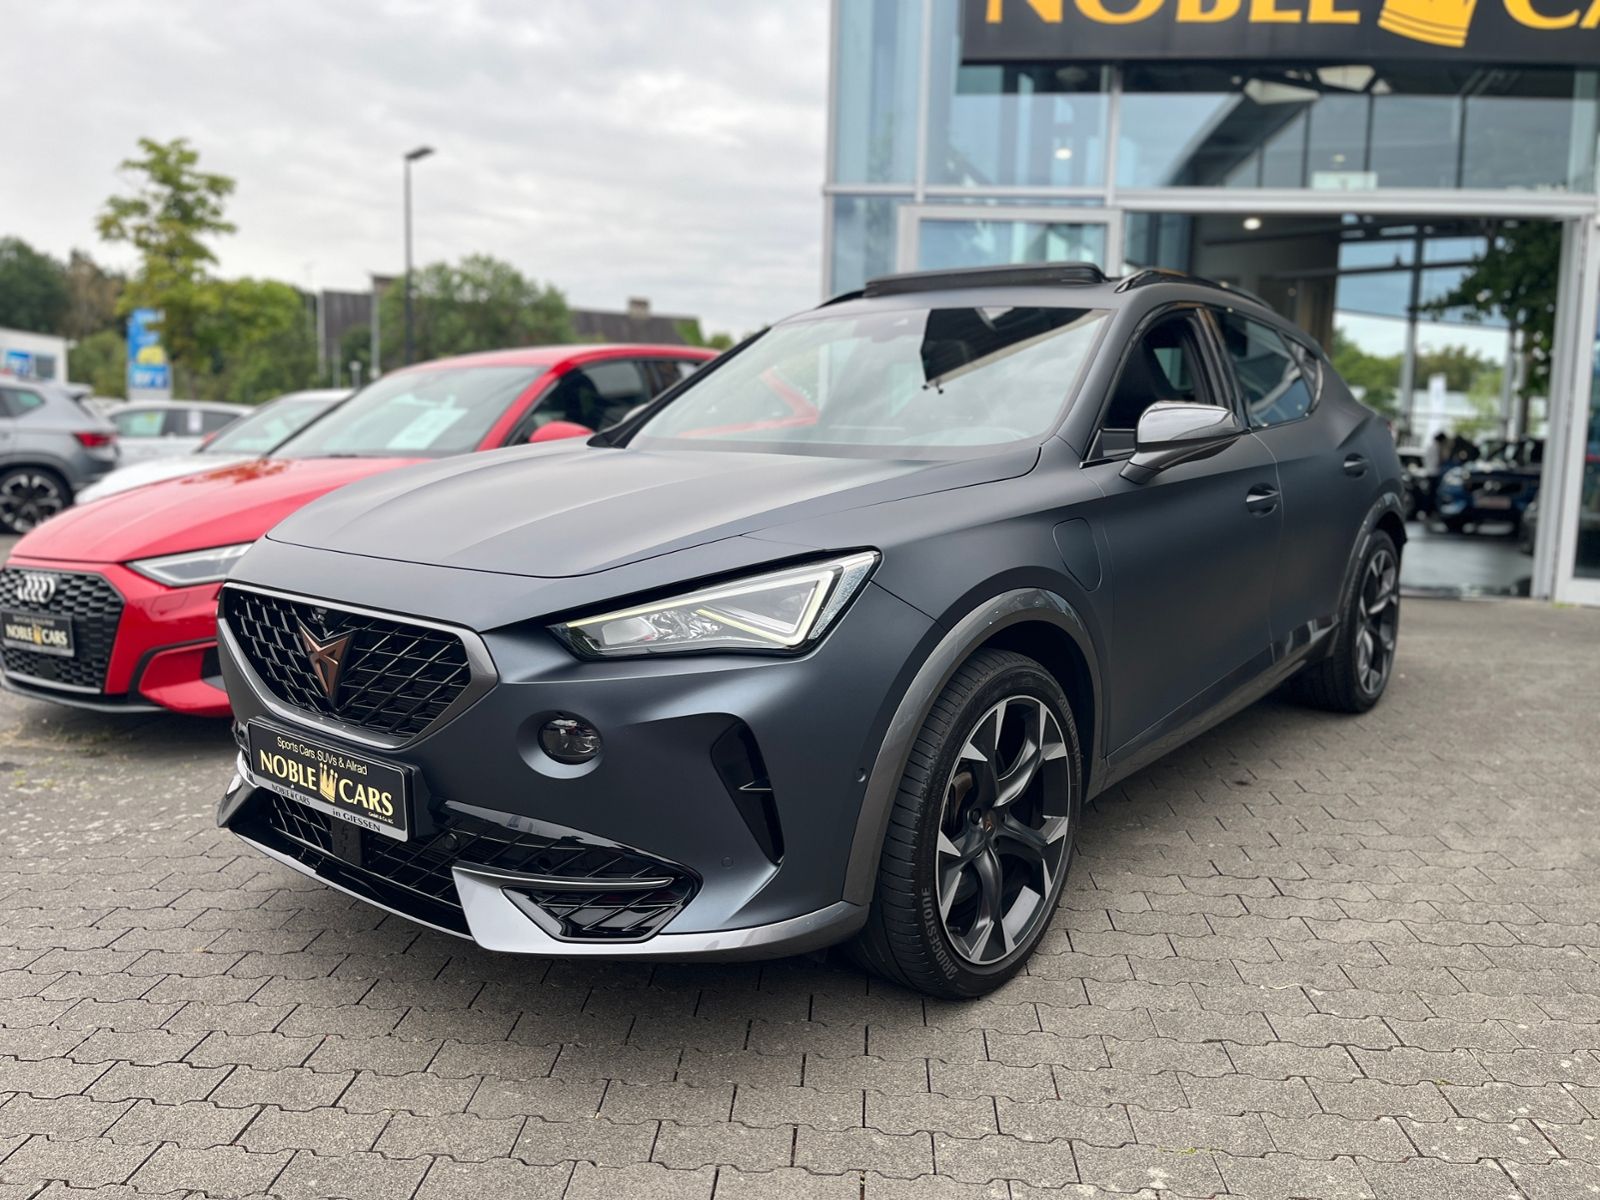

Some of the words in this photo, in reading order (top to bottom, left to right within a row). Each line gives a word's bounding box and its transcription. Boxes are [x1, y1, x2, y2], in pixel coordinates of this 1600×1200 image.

[41, 629, 68, 646] CARS
[277, 736, 298, 753] Sports
[317, 750, 338, 766] SUVs
[338, 757, 345, 768] &
[346, 759, 368, 776] Allrad
[260, 749, 317, 791] NOBLE
[338, 778, 394, 817] CARS
[295, 790, 311, 806] CARS
[332, 807, 341, 817] in
[343, 812, 381, 832] GIESSEN
[921, 887, 959, 980] BRIDGESTONE
